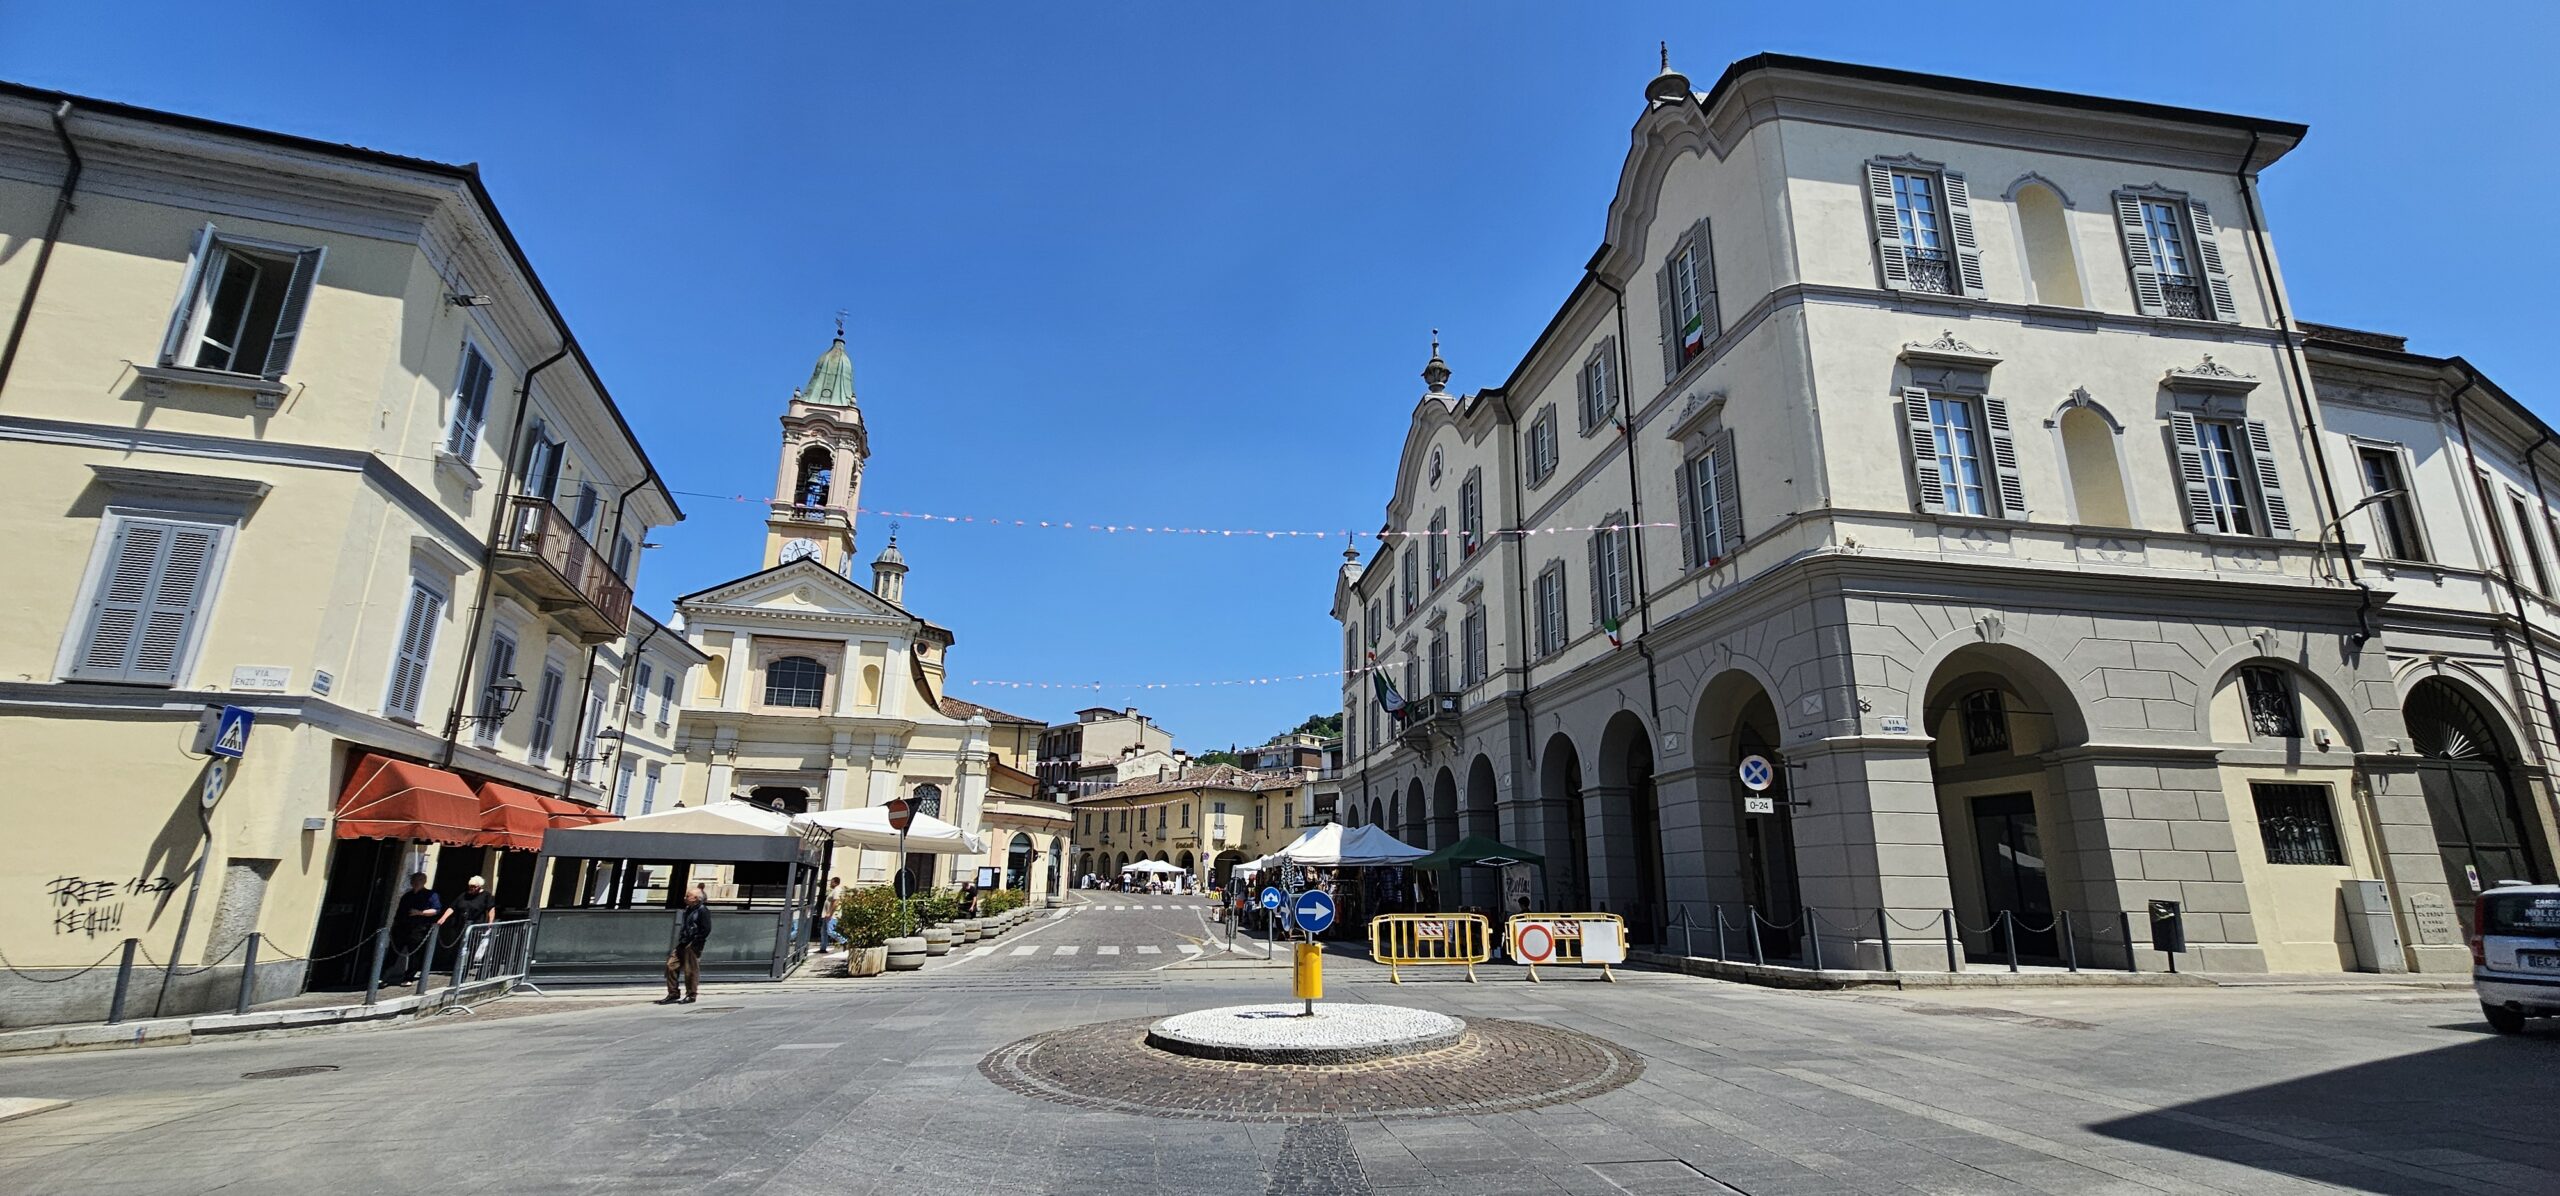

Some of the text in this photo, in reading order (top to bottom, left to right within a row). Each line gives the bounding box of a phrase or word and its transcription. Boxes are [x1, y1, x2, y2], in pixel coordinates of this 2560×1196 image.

[255, 669, 269, 677] VIA
[234, 677, 256, 686] ENZO
[1750, 801, 1768, 810] 0-24
